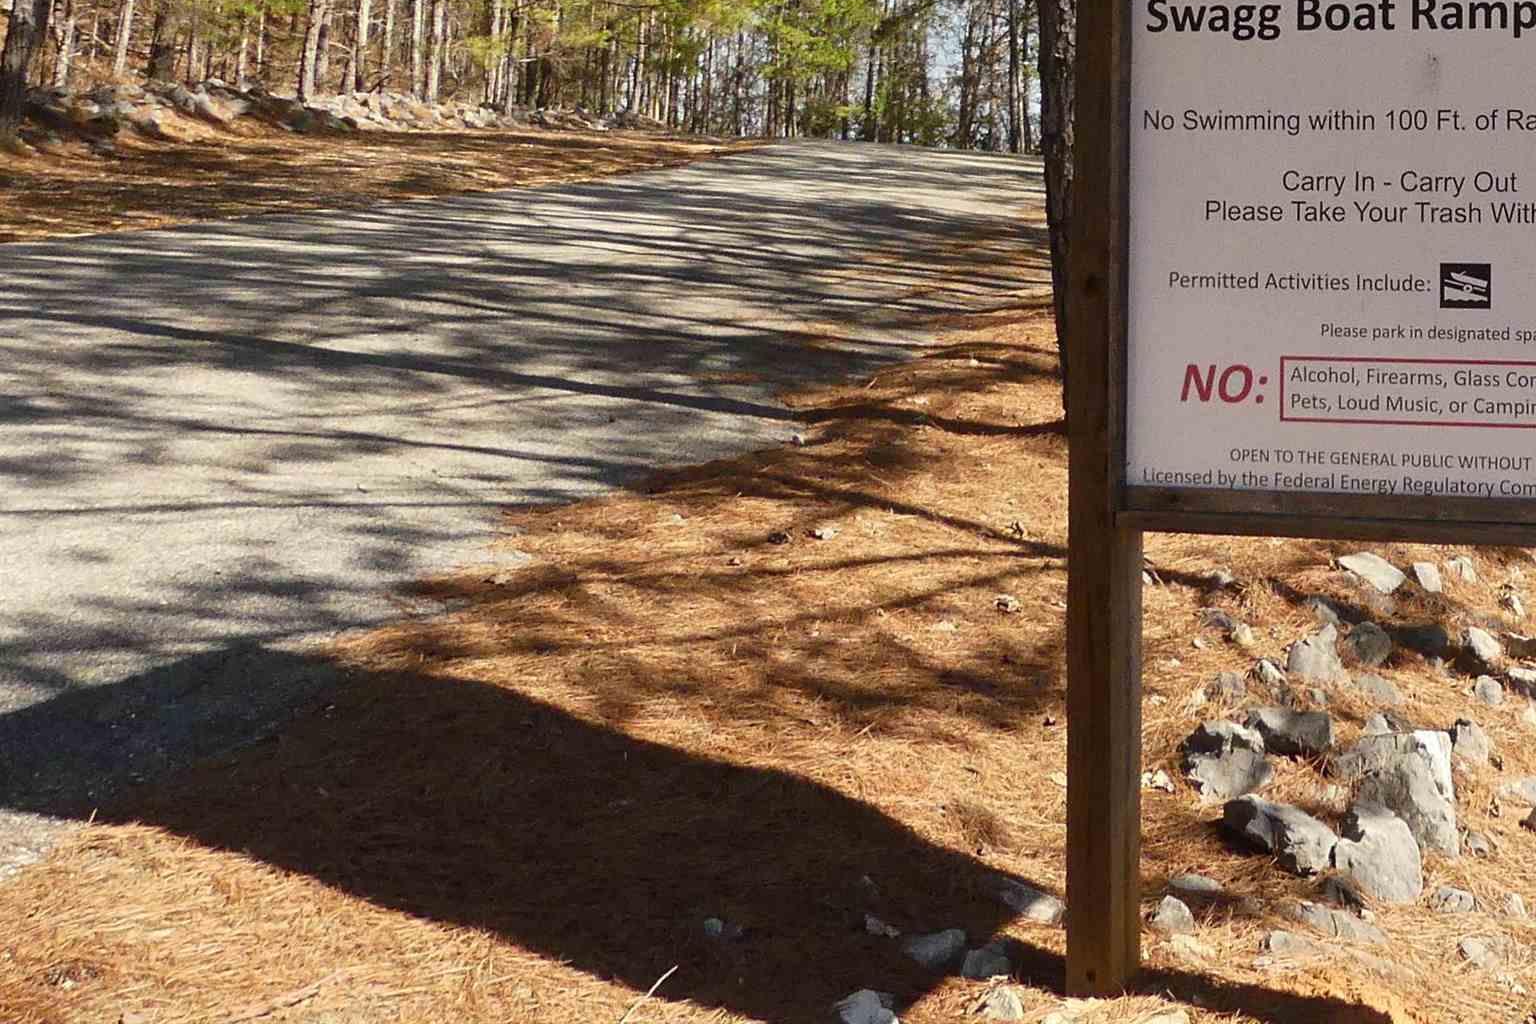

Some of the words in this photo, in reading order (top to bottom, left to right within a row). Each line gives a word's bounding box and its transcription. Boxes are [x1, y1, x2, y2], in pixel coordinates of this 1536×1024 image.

[1144, 110, 1174, 130] No
[1183, 109, 1300, 136] Swimming
[1308, 109, 1375, 130] within
[1386, 109, 1427, 130] 100
[1437, 109, 1465, 131] Ft.
[1475, 109, 1499, 130] of
[1283, 170, 1346, 197] Carry
[1355, 171, 1374, 192] In
[1401, 170, 1465, 198] Carry
[1474, 171, 1517, 192] Out
[1206, 200, 1283, 221] Please
[1291, 201, 1345, 222] Take
[1353, 201, 1408, 224] Your
[1414, 202, 1481, 224] Trash
[1169, 272, 1258, 289] Permitted
[1265, 272, 1349, 291] Activities
[1357, 274, 1431, 292] Include:
[1321, 323, 1367, 338] Please
[1373, 324, 1405, 341] park
[1410, 326, 1422, 339] in
[1428, 326, 1510, 343] designated
[1180, 364, 1268, 404] NO:
[1291, 366, 1360, 386] Alcohol,
[1367, 368, 1447, 388] Firearms,
[1454, 370, 1500, 387] Glass
[1291, 394, 1331, 413] Pets,
[1338, 394, 1379, 410] Loud
[1386, 396, 1442, 415] Music,
[1449, 401, 1468, 414] or
[1230, 448, 1269, 462] OPEN
[1274, 450, 1293, 463] TO
[1298, 450, 1325, 464] THE
[1330, 452, 1397, 466] GENERAL
[1402, 454, 1453, 468] PUBLIC
[1458, 456, 1532, 471] WITHOUT
[1143, 469, 1213, 485] Licensed
[1218, 469, 1236, 488] by
[1242, 471, 1269, 486] the
[1275, 472, 1334, 488] Federal
[1341, 474, 1397, 495] Energy
[1403, 477, 1495, 498] Regulatory
